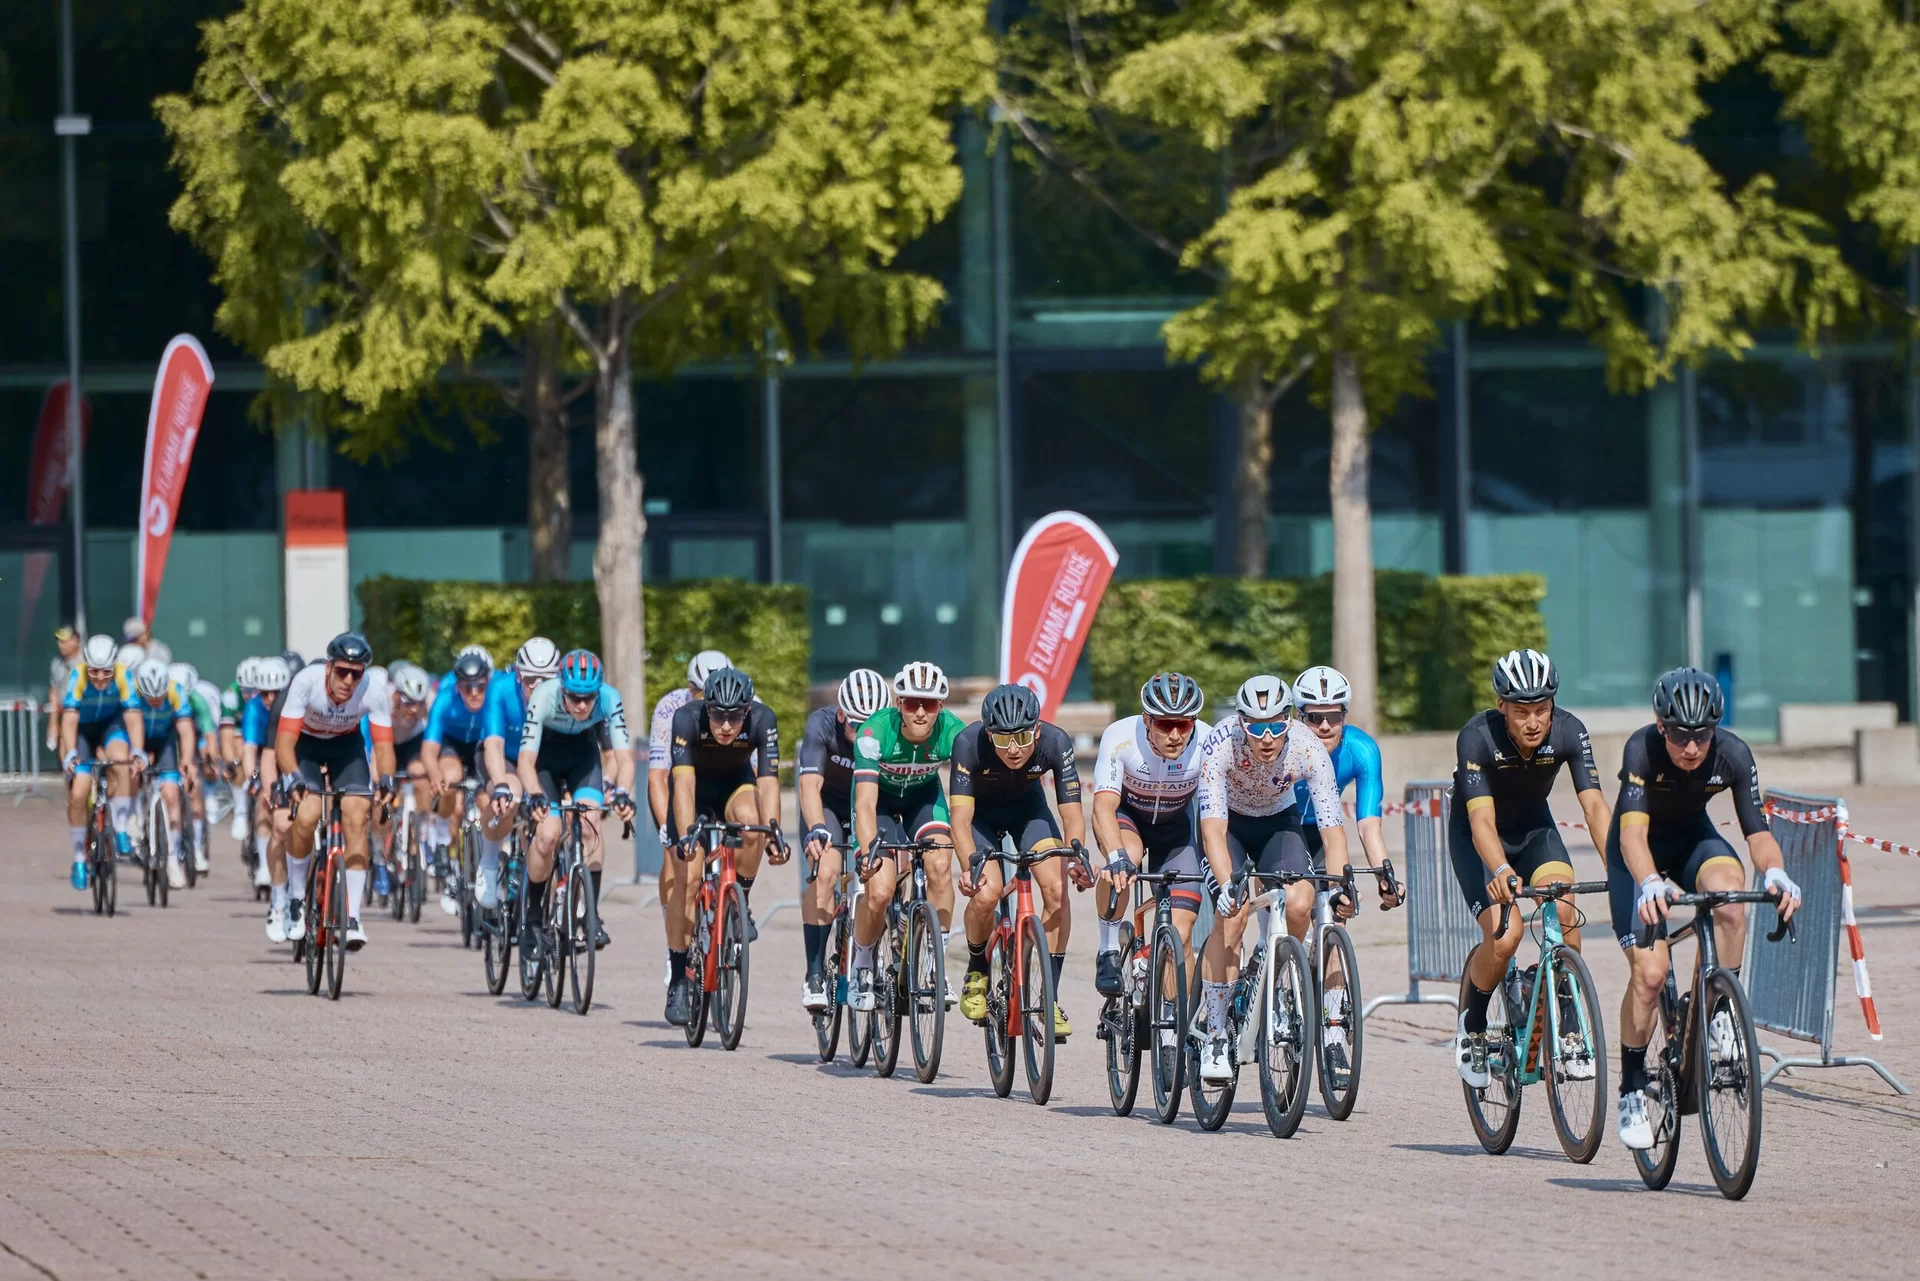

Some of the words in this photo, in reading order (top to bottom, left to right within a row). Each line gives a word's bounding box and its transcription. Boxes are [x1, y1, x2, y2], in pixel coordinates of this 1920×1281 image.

[1029, 602, 1069, 674] FLAMME
[1055, 552, 1094, 606] ROUGE
[1202, 724, 1232, 756] 5411
[1125, 776, 1197, 791] EHRMANN
